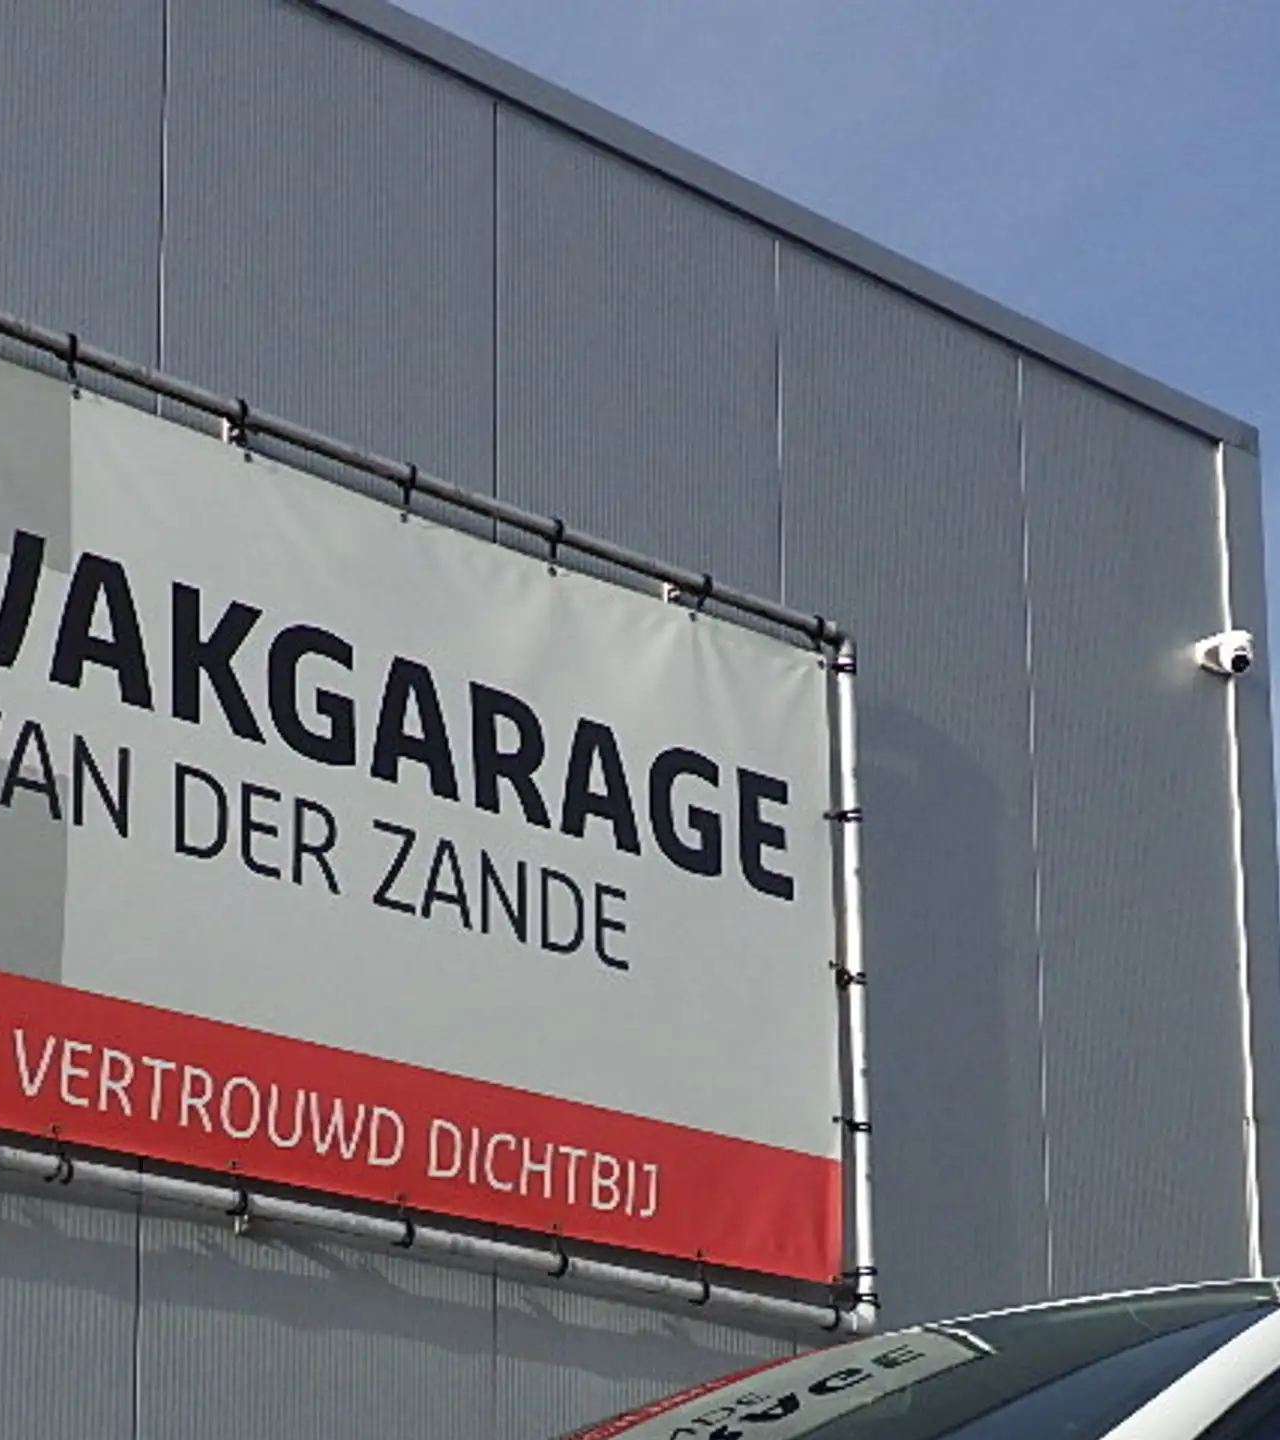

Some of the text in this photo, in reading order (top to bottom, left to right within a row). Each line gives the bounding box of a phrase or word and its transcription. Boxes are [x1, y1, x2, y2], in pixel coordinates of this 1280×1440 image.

[174, 761, 341, 896] DER
[372, 819, 630, 971] ZANDE
[13, 1028, 406, 1167] VERTROUWD
[426, 1118, 660, 1218] DICHTBIJ
